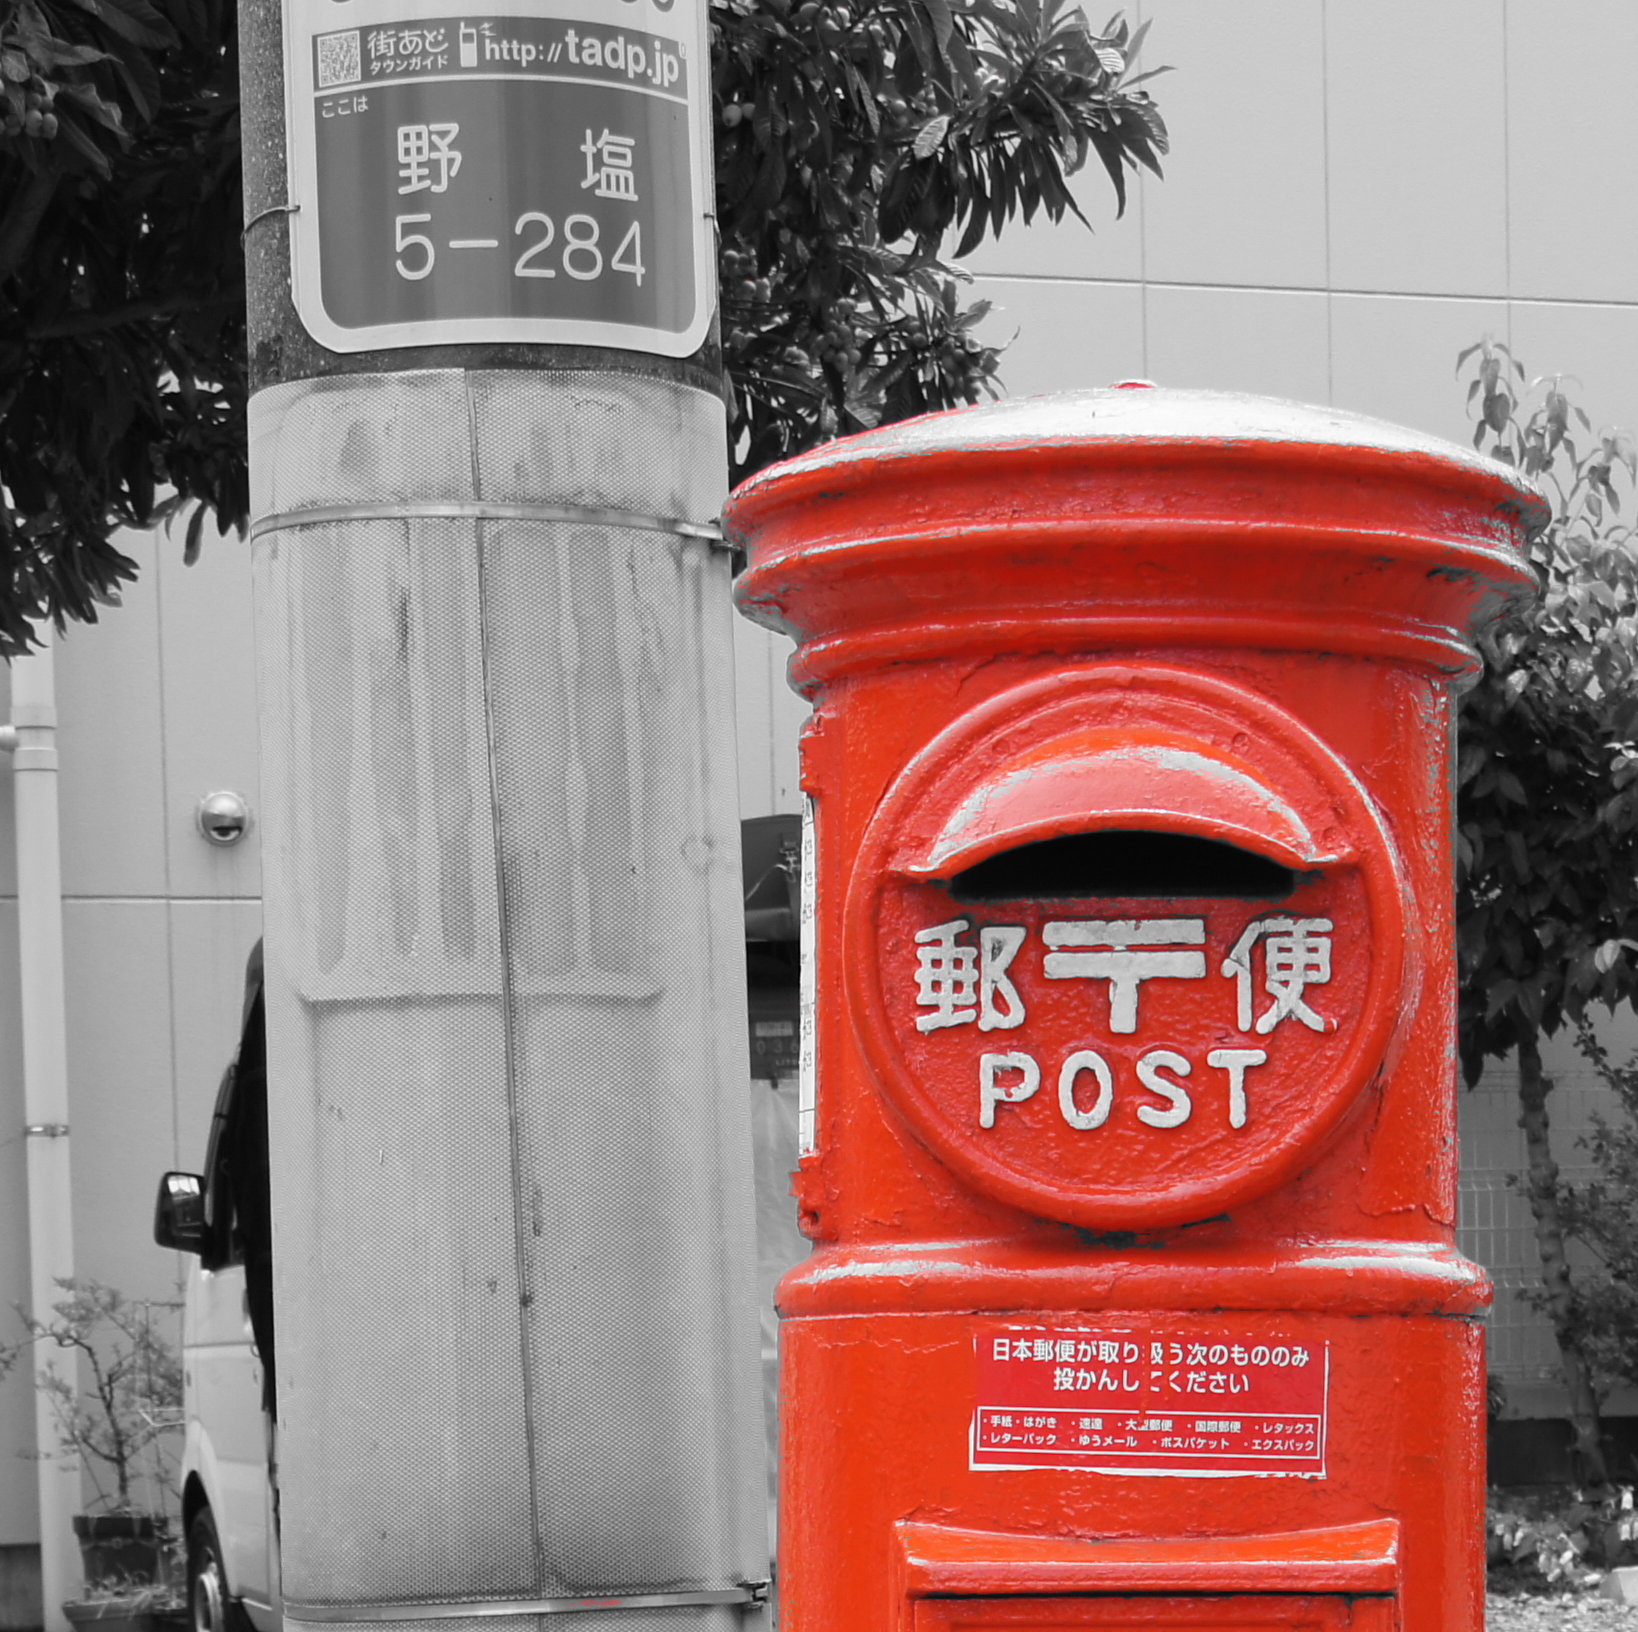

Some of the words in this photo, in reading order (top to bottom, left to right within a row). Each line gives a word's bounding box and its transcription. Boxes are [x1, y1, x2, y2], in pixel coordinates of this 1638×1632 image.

[366, 27, 449, 60] 街あど
[369, 55, 449, 76] タウンガイド
[320, 95, 369, 119] ここは
[978, 1048, 1267, 1131] POST
[1078, 1434, 1138, 1448] ゆうメール
